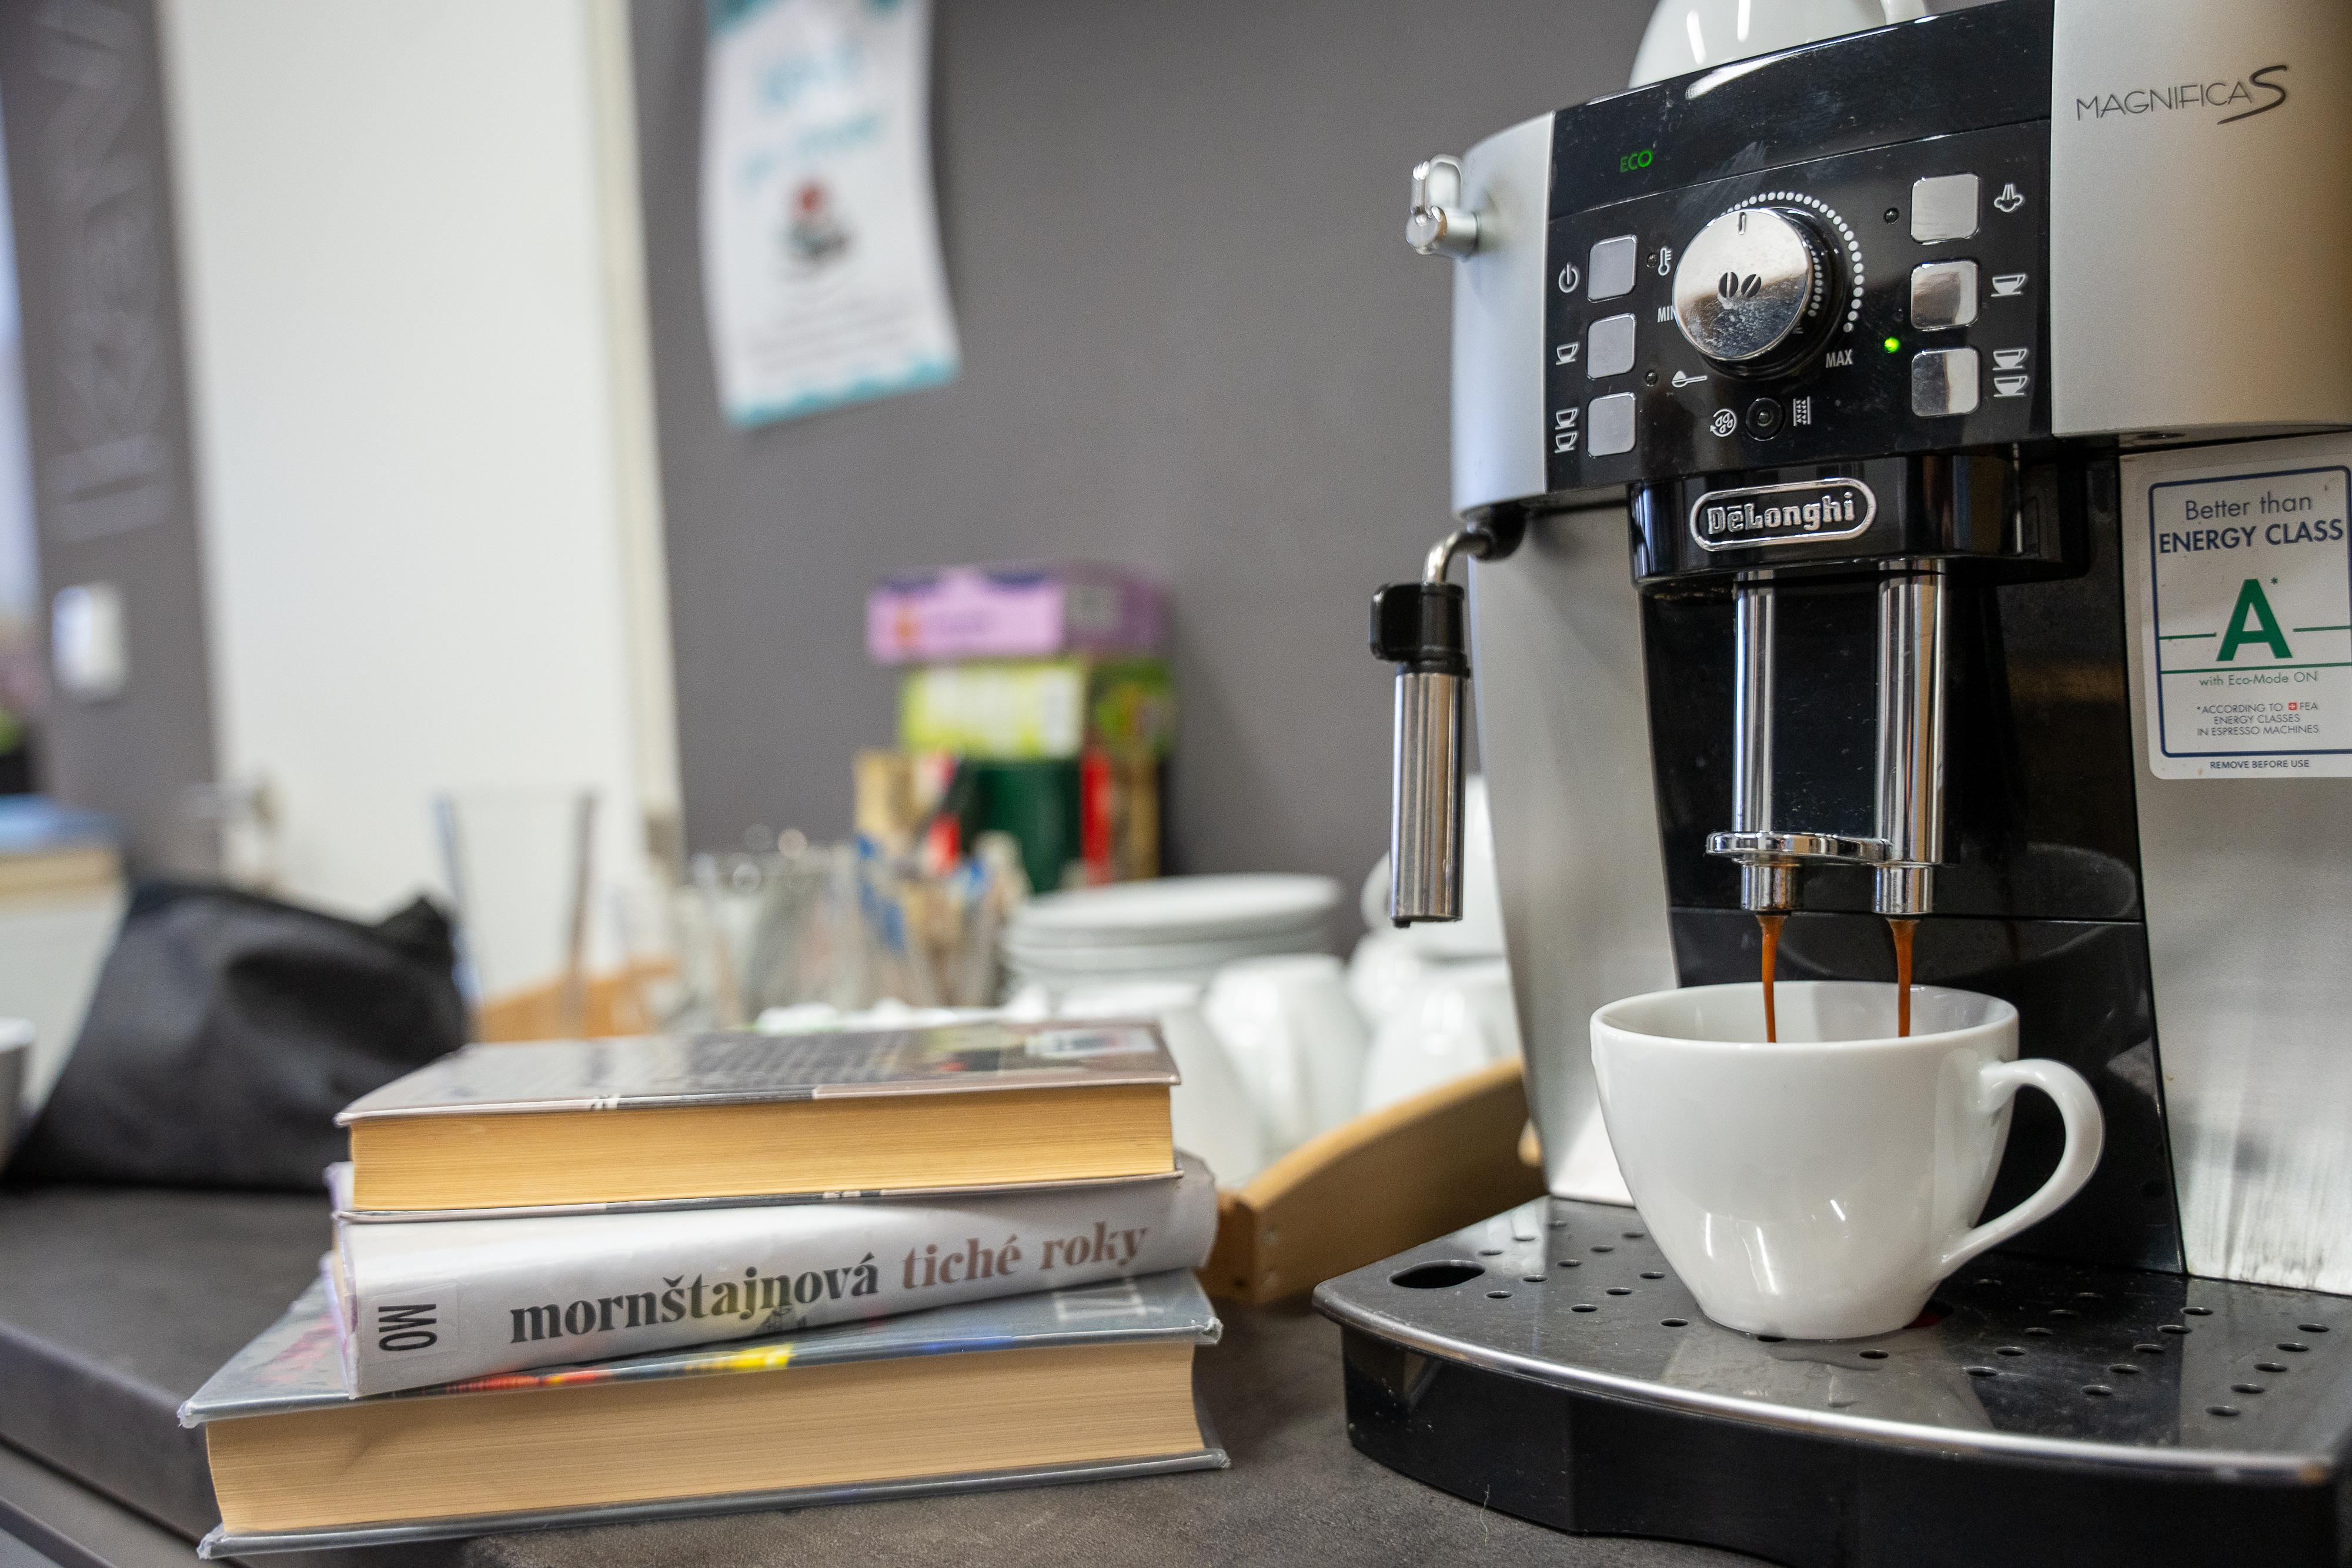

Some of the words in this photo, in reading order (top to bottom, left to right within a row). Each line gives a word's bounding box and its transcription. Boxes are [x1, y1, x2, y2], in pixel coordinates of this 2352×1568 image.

[2076, 80, 2253, 121] MAGNIFICA
[1620, 149, 1652, 173] ECO
[1826, 349, 1853, 368] MAX
[2184, 500, 2250, 520] Better
[2260, 491, 2311, 514] than
[2159, 526, 2257, 553] ENERGY
[2265, 519, 2343, 546] CLASS
[2199, 675, 2224, 686] with
[2228, 672, 2289, 686] Eco-Mode
[2293, 671, 2318, 683] ON
[2268, 703, 2283, 712] TO
[2300, 702, 2318, 711] FEA
[2197, 728, 2209, 736] IN
[2211, 726, 2260, 736] ESPRESSO
[2263, 724, 2319, 734] MACHINES
[2214, 715, 2254, 725] ENERGY
[2257, 714, 2300, 723] CLASSES
[2210, 761, 2250, 769] REMOVE
[2251, 760, 2288, 768] BEFORE
[2291, 760, 2310, 768] USE
[510, 1251, 880, 1344] mornštajnová
[900, 1233, 1022, 1289] tiché
[1039, 1221, 1149, 1270] roky
[378, 1303, 438, 1351] MO
